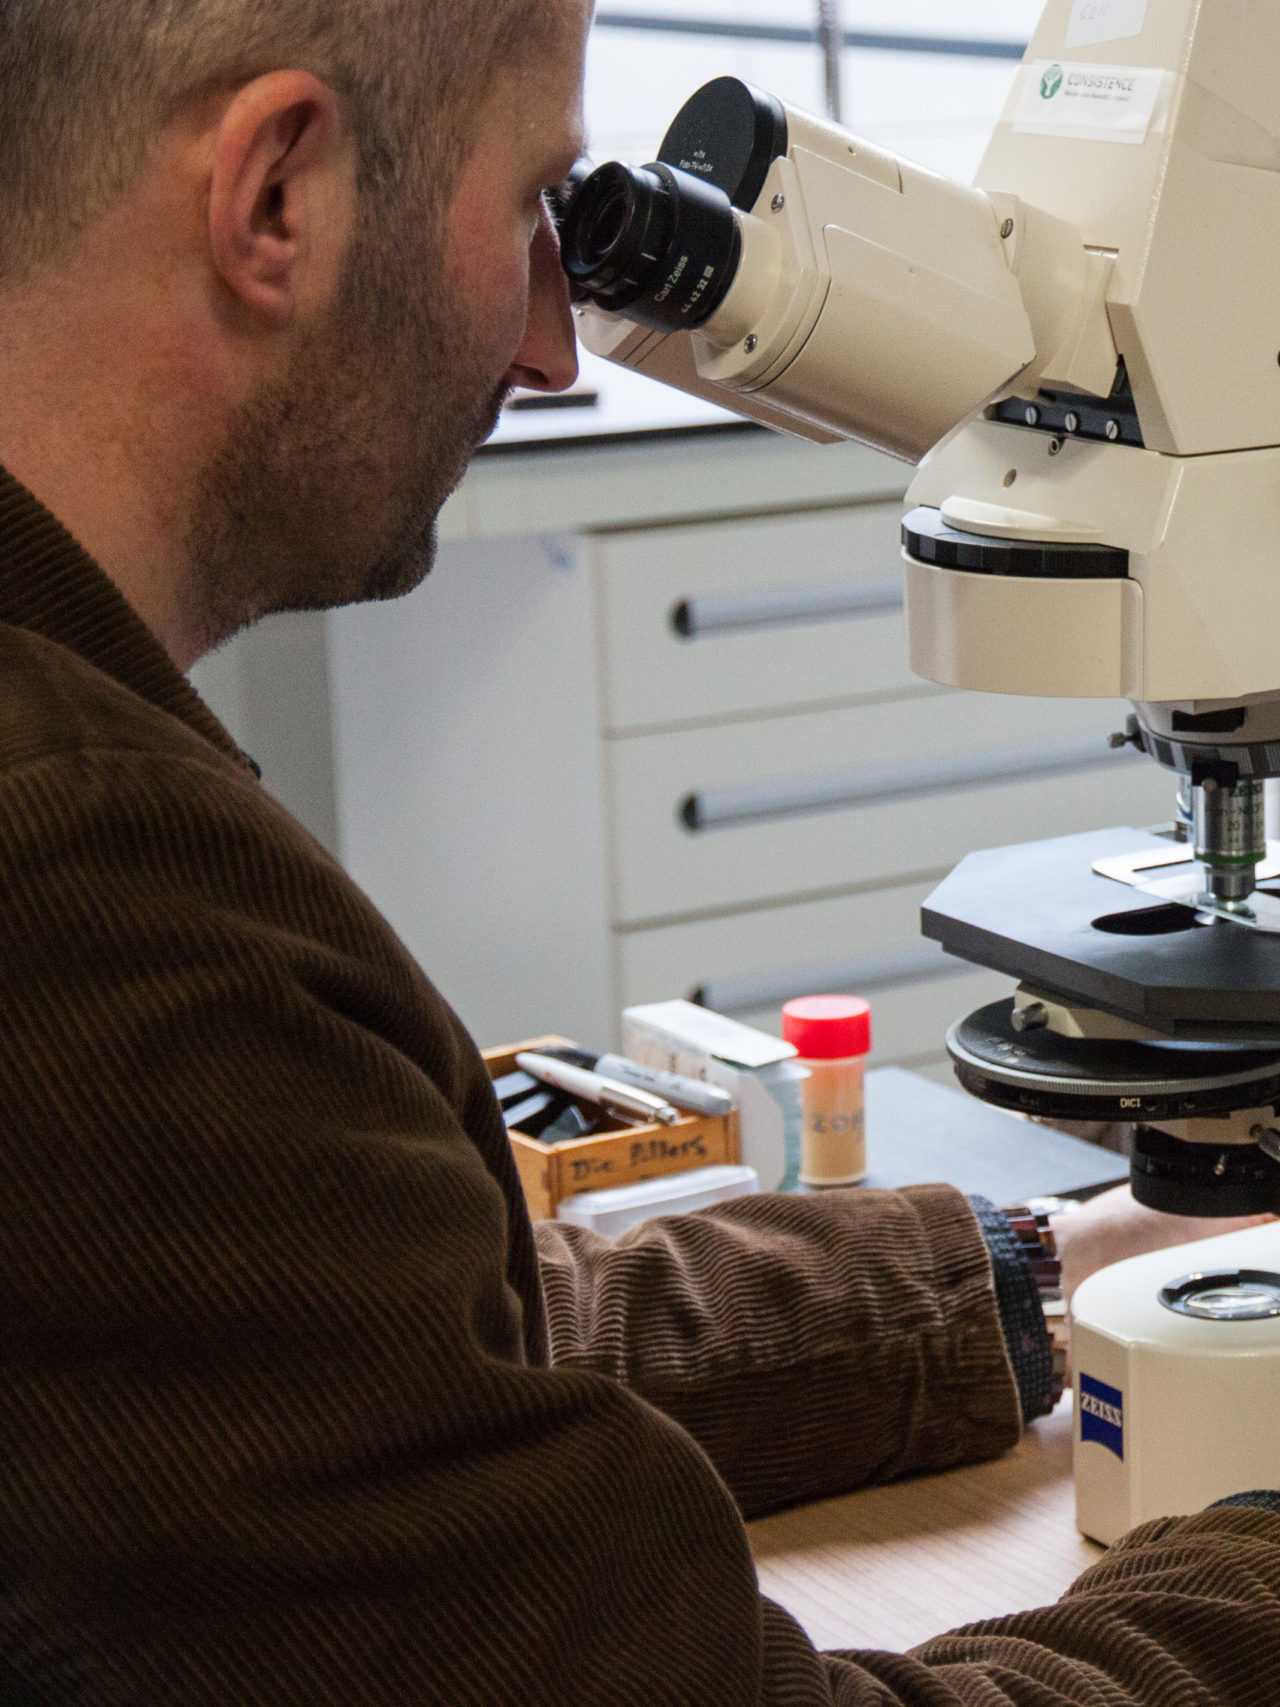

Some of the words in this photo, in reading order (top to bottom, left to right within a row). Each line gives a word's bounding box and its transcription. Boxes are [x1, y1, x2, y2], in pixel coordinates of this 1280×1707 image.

[1067, 72, 1136, 92] CONSISTENCE
[654, 282, 672, 302] Carl
[667, 255, 688, 284] Zeiss
[1080, 1391, 1122, 1429] ZEISS
